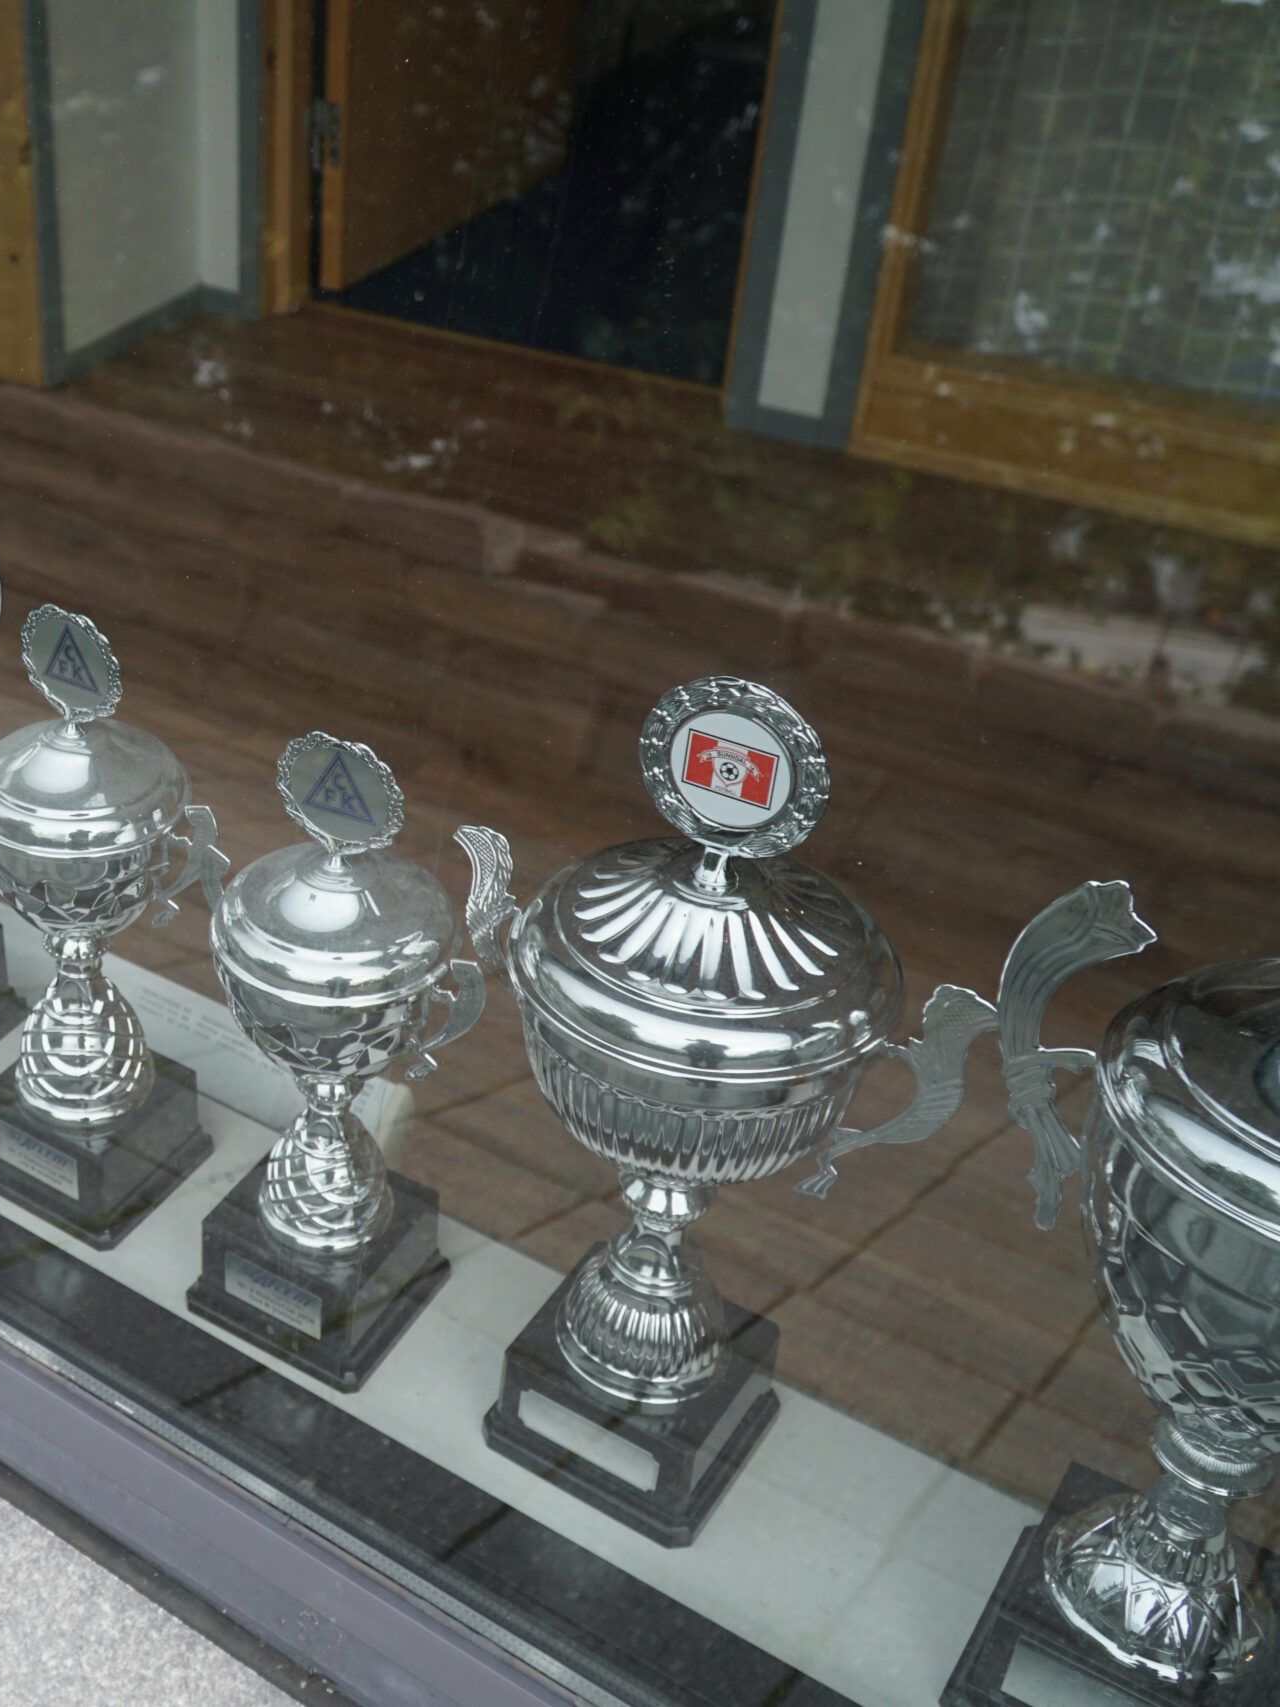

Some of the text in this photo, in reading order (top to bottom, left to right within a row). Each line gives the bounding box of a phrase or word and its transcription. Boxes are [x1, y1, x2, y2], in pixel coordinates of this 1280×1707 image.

[59, 660, 84, 683] FK
[717, 751, 746, 764] SUNNDAL
[333, 773, 345, 790] C
[325, 790, 356, 811] FK
